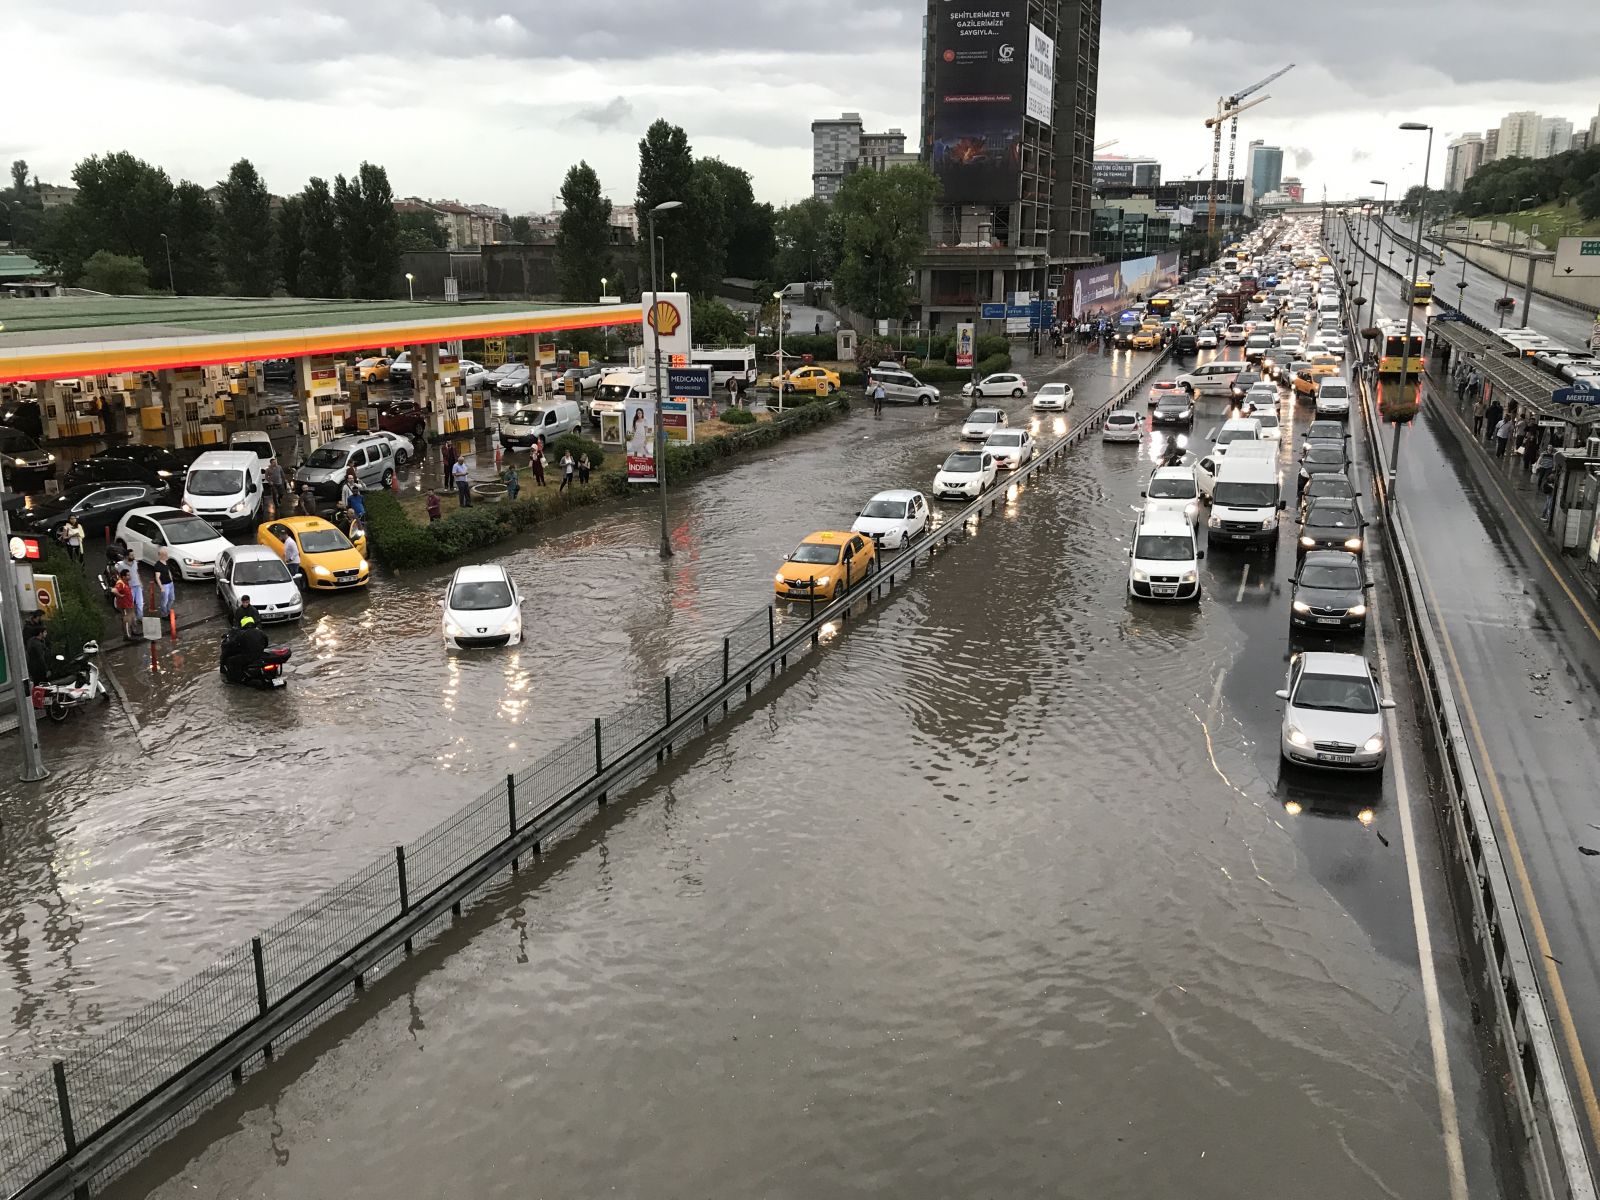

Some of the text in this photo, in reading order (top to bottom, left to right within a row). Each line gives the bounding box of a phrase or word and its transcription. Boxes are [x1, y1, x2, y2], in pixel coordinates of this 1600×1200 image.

[950, 10, 1000, 20] ŞEHİTLERİMİZE
[956, 19, 1004, 28] GAZİLERİMİZE
[671, 375, 703, 383] MEDICANA
[1566, 394, 1595, 402] MERTER
[628, 462, 654, 472] İNDİRİM
